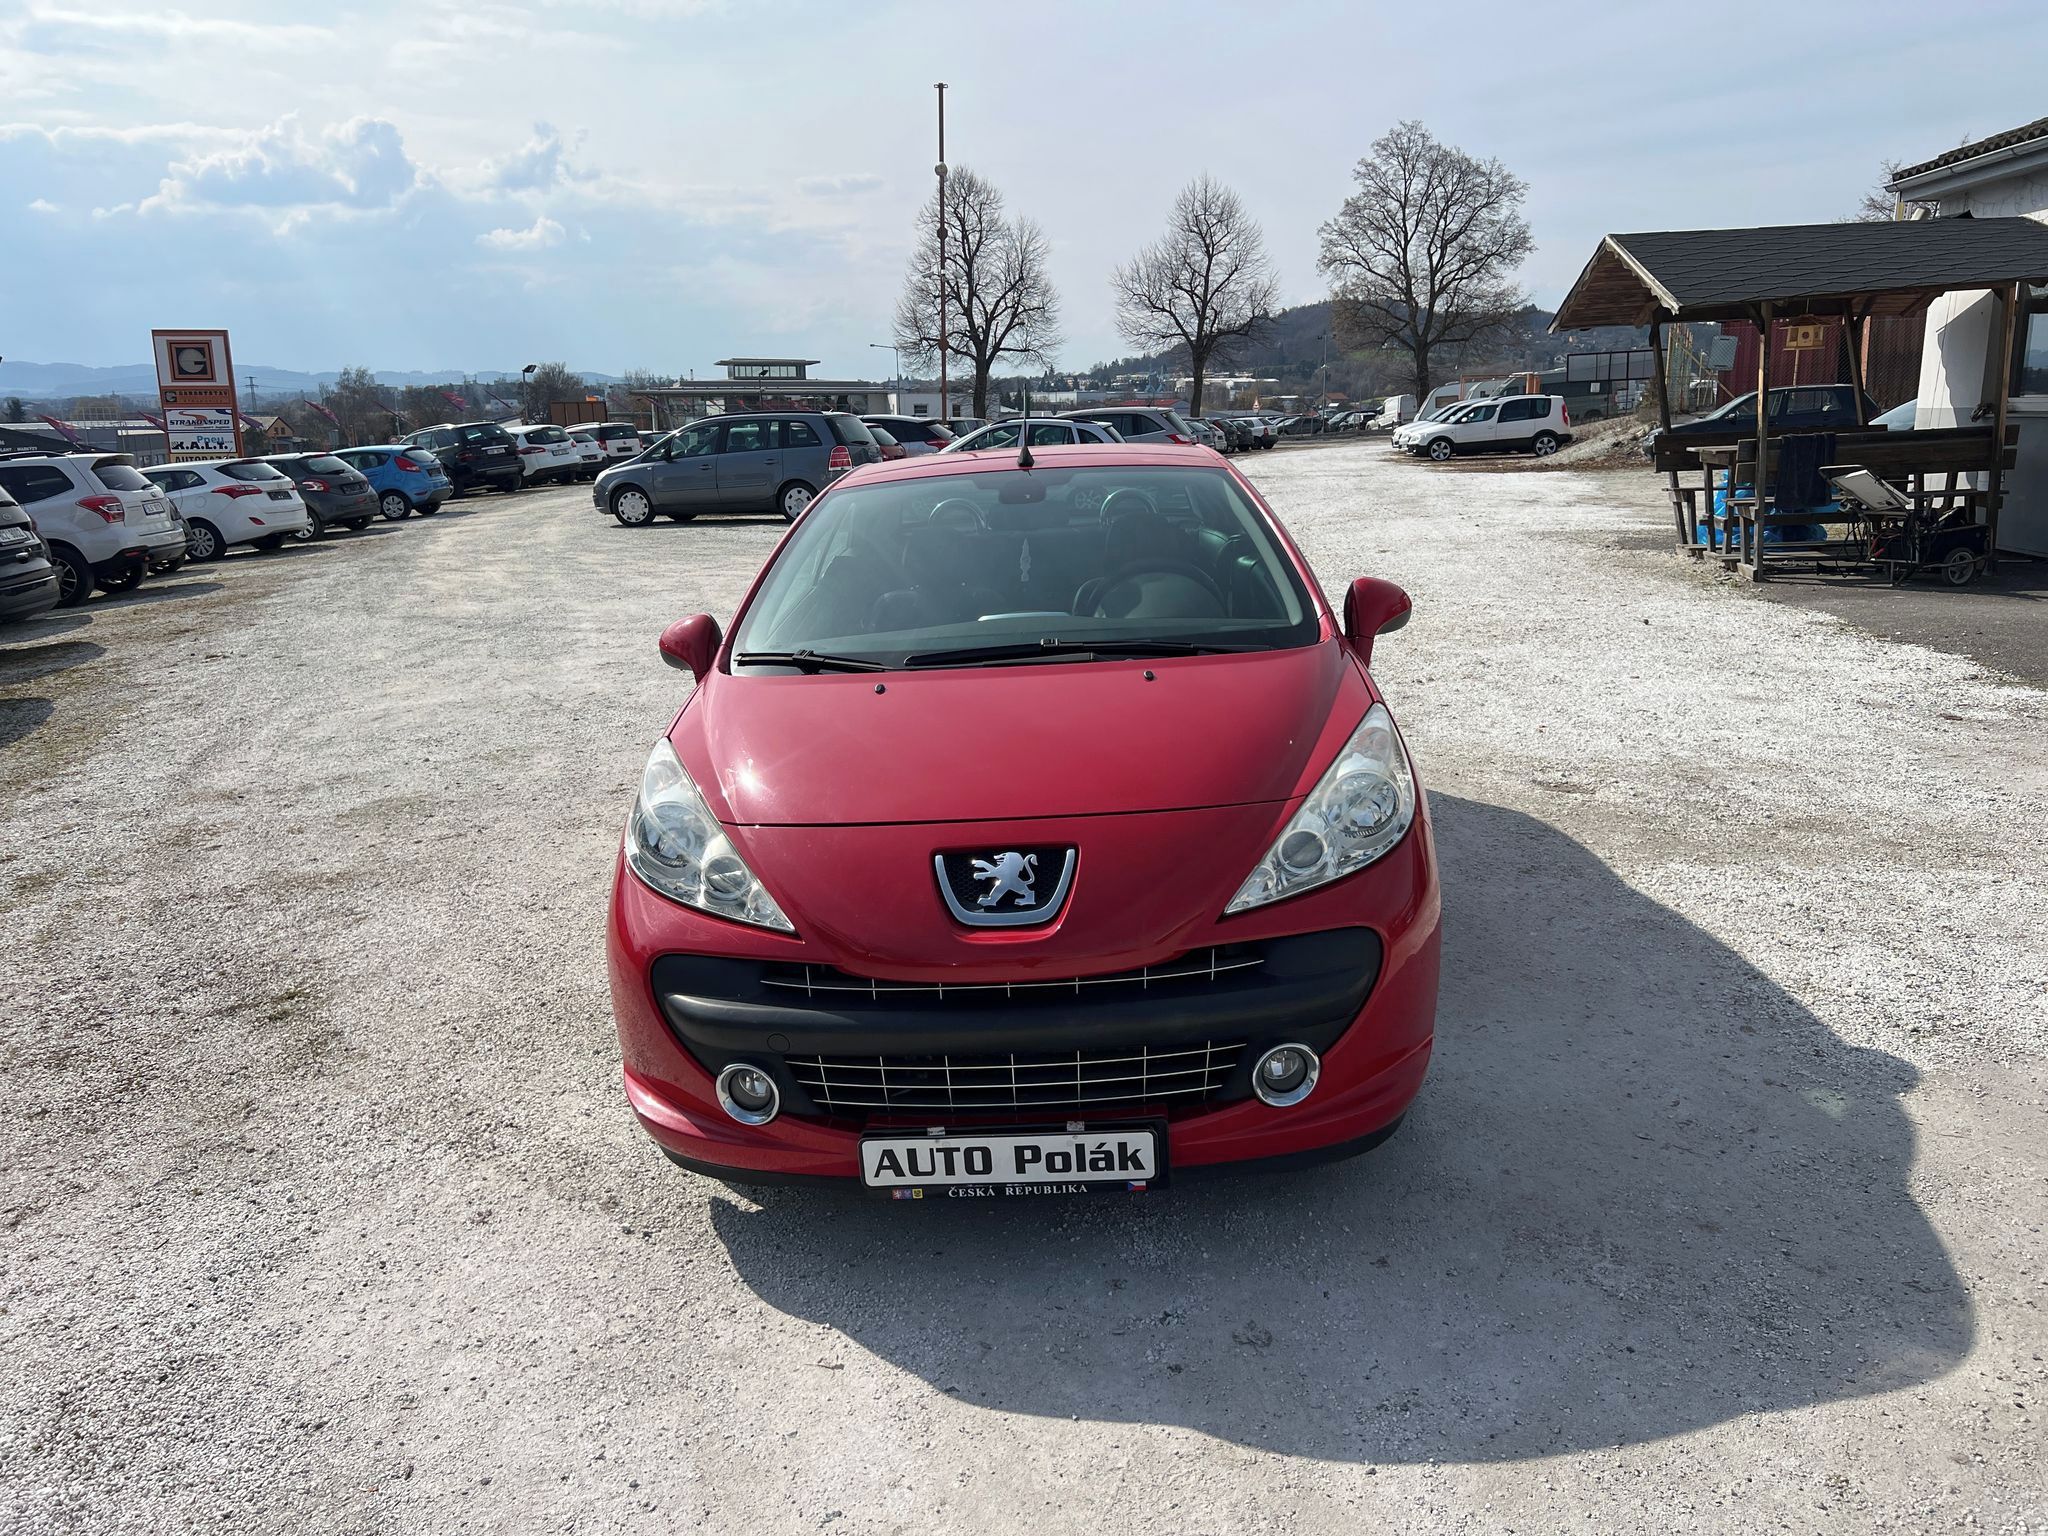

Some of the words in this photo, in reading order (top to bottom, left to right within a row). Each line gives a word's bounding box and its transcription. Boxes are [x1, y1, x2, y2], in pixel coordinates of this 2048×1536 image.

[196, 435, 225, 444] Pneu
[873, 1146, 993, 1178] AUTO
[1013, 1141, 1146, 1175] Polák
[948, 1185, 995, 1198] ČESKÁ
[1005, 1183, 1088, 1196] REPUBLIKA
